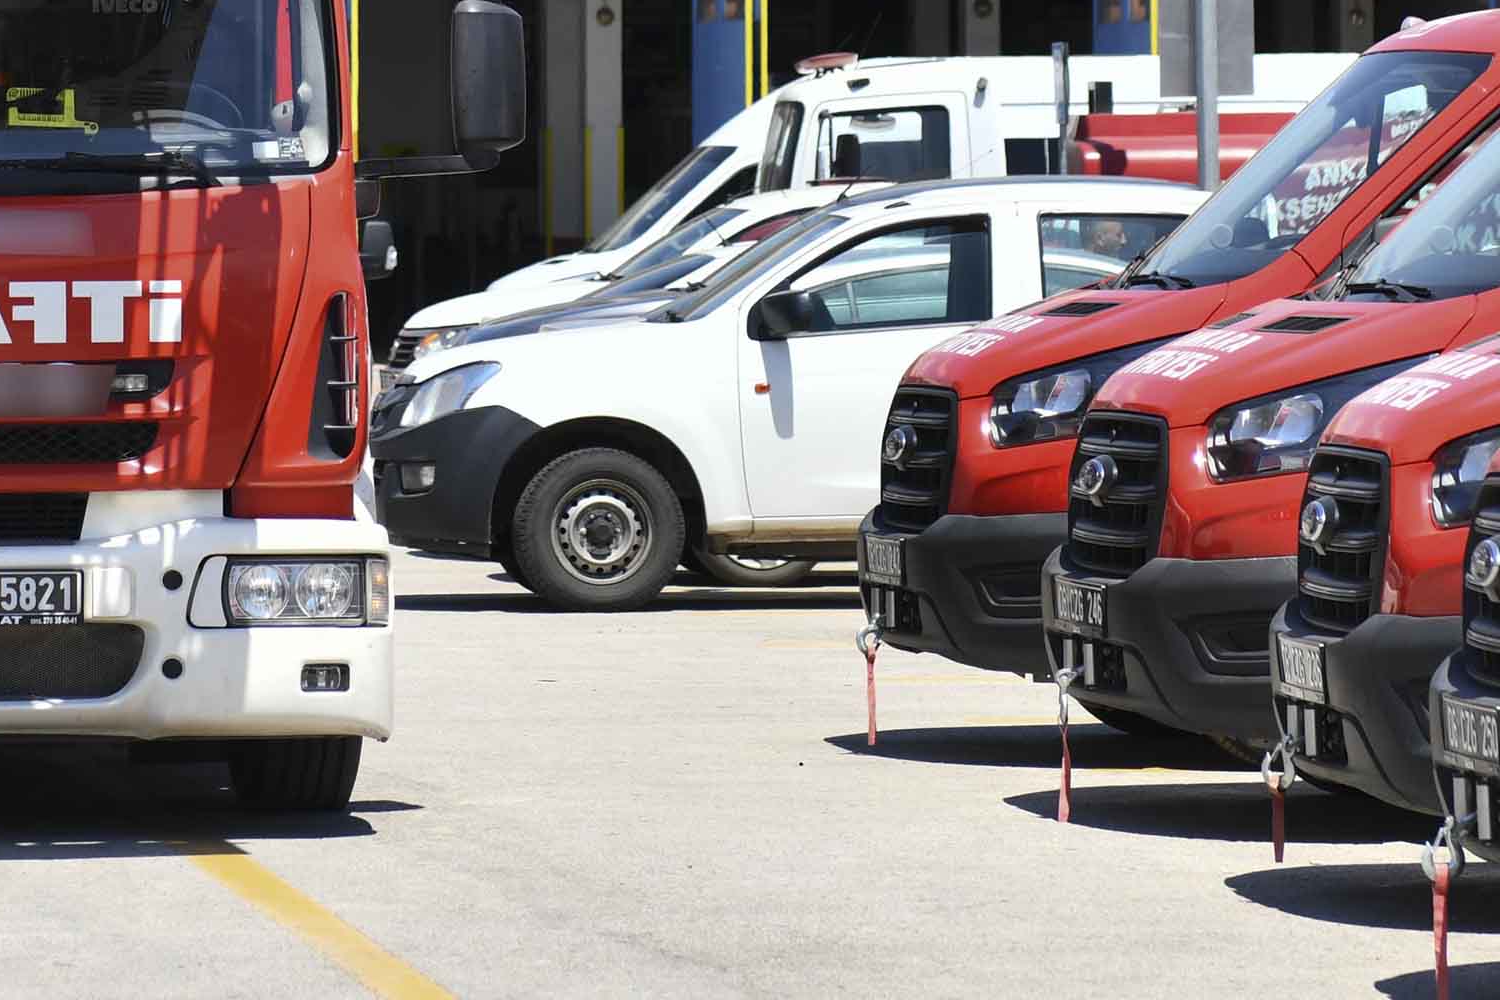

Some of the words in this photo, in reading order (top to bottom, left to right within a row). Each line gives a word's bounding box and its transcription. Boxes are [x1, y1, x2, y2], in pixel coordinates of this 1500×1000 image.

[0, 576, 72, 613] 5821
[1087, 591, 1103, 625] 246
[1460, 709, 1478, 754] CZG
[1481, 713, 1499, 759] 250
